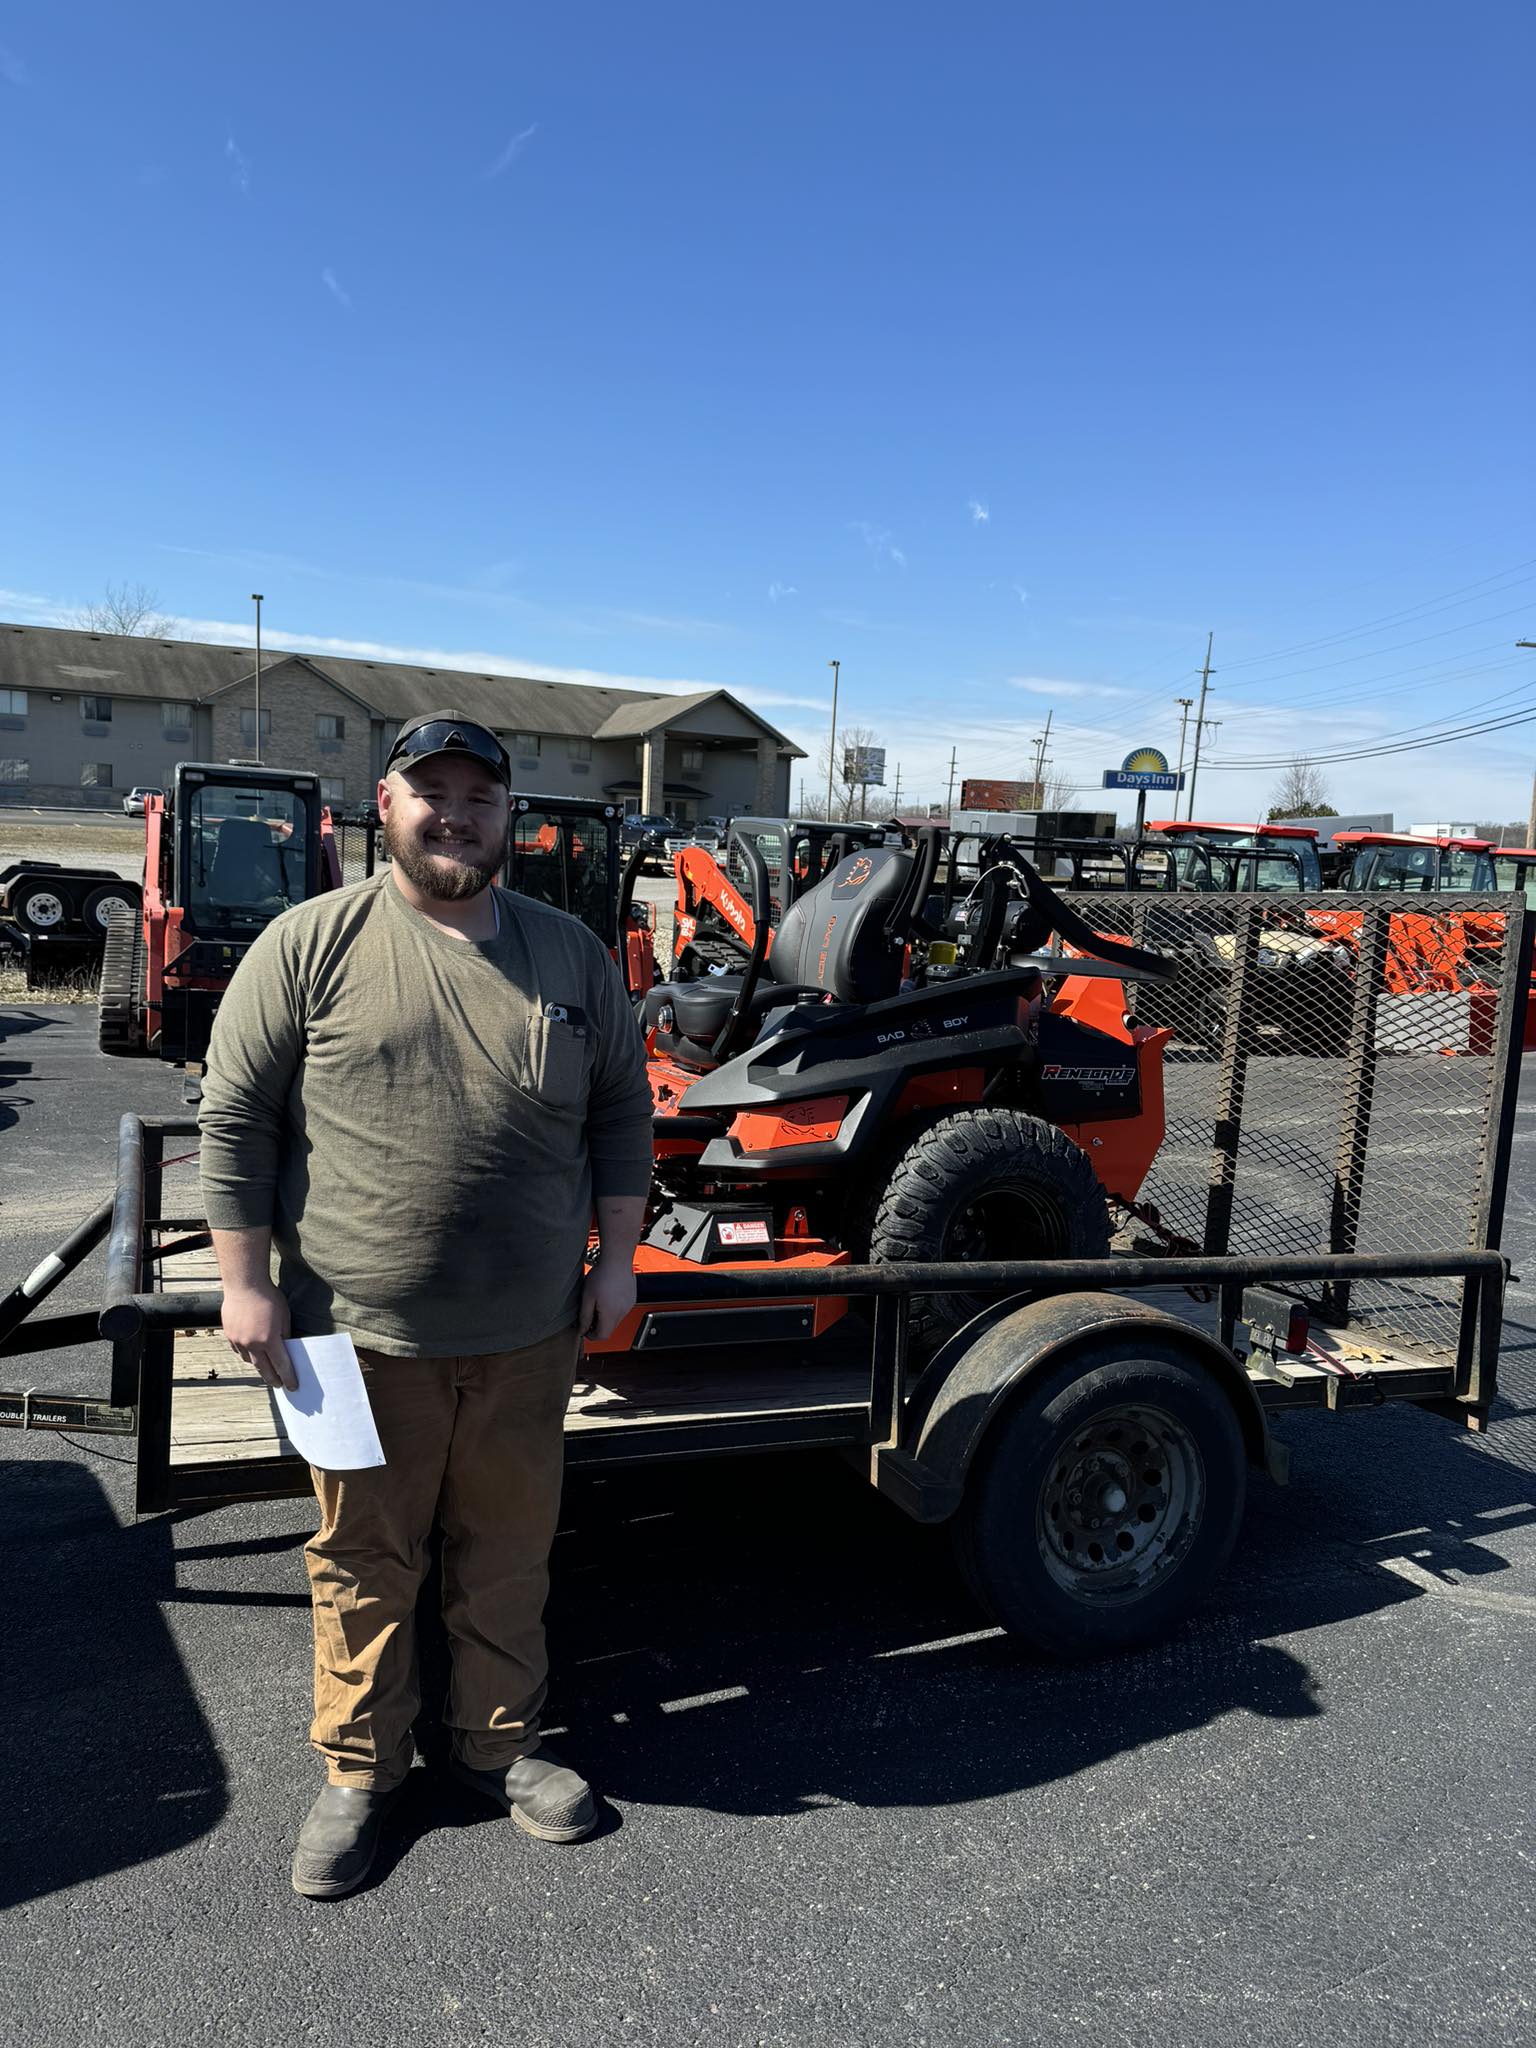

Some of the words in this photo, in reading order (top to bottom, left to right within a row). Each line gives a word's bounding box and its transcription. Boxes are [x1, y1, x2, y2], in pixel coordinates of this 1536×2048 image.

[1117, 772, 1151, 784] Days
[1151, 774, 1175, 784] Inn
[720, 889, 746, 931] Kubota
[877, 1030, 905, 1043] BAD
[943, 1016, 968, 1028] BOY
[1041, 1064, 1136, 1081] RENEGADE
[33, 1414, 67, 1423] TRAILERS
